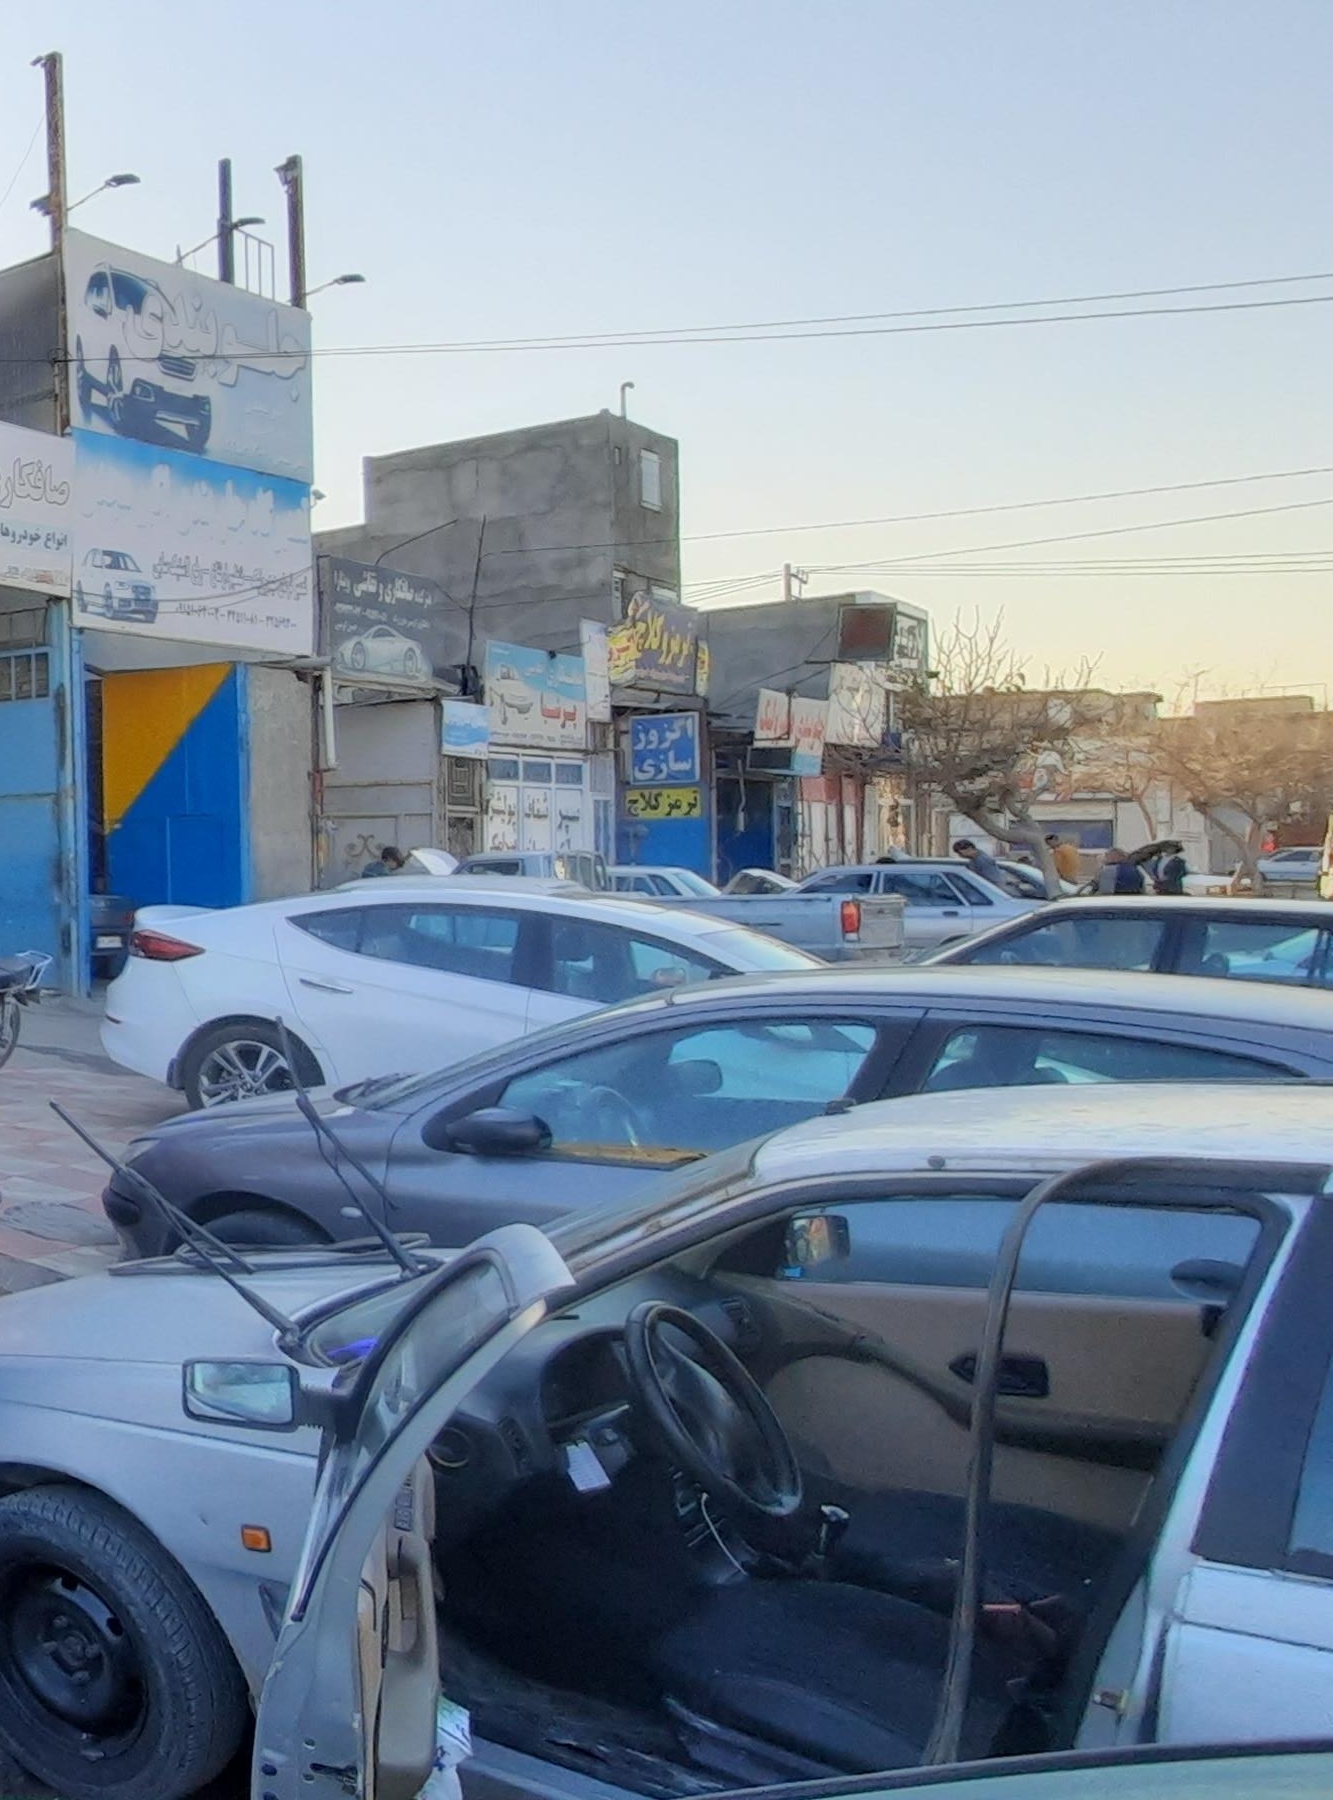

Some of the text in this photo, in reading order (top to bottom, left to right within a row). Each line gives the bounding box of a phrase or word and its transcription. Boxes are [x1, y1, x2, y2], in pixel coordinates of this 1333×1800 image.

[43, 533, 68, 550] انواع
[633, 717, 693, 750] اگزوز
[634, 749, 692, 780] سازی
[627, 789, 698, 817] ترمز کلاچ
